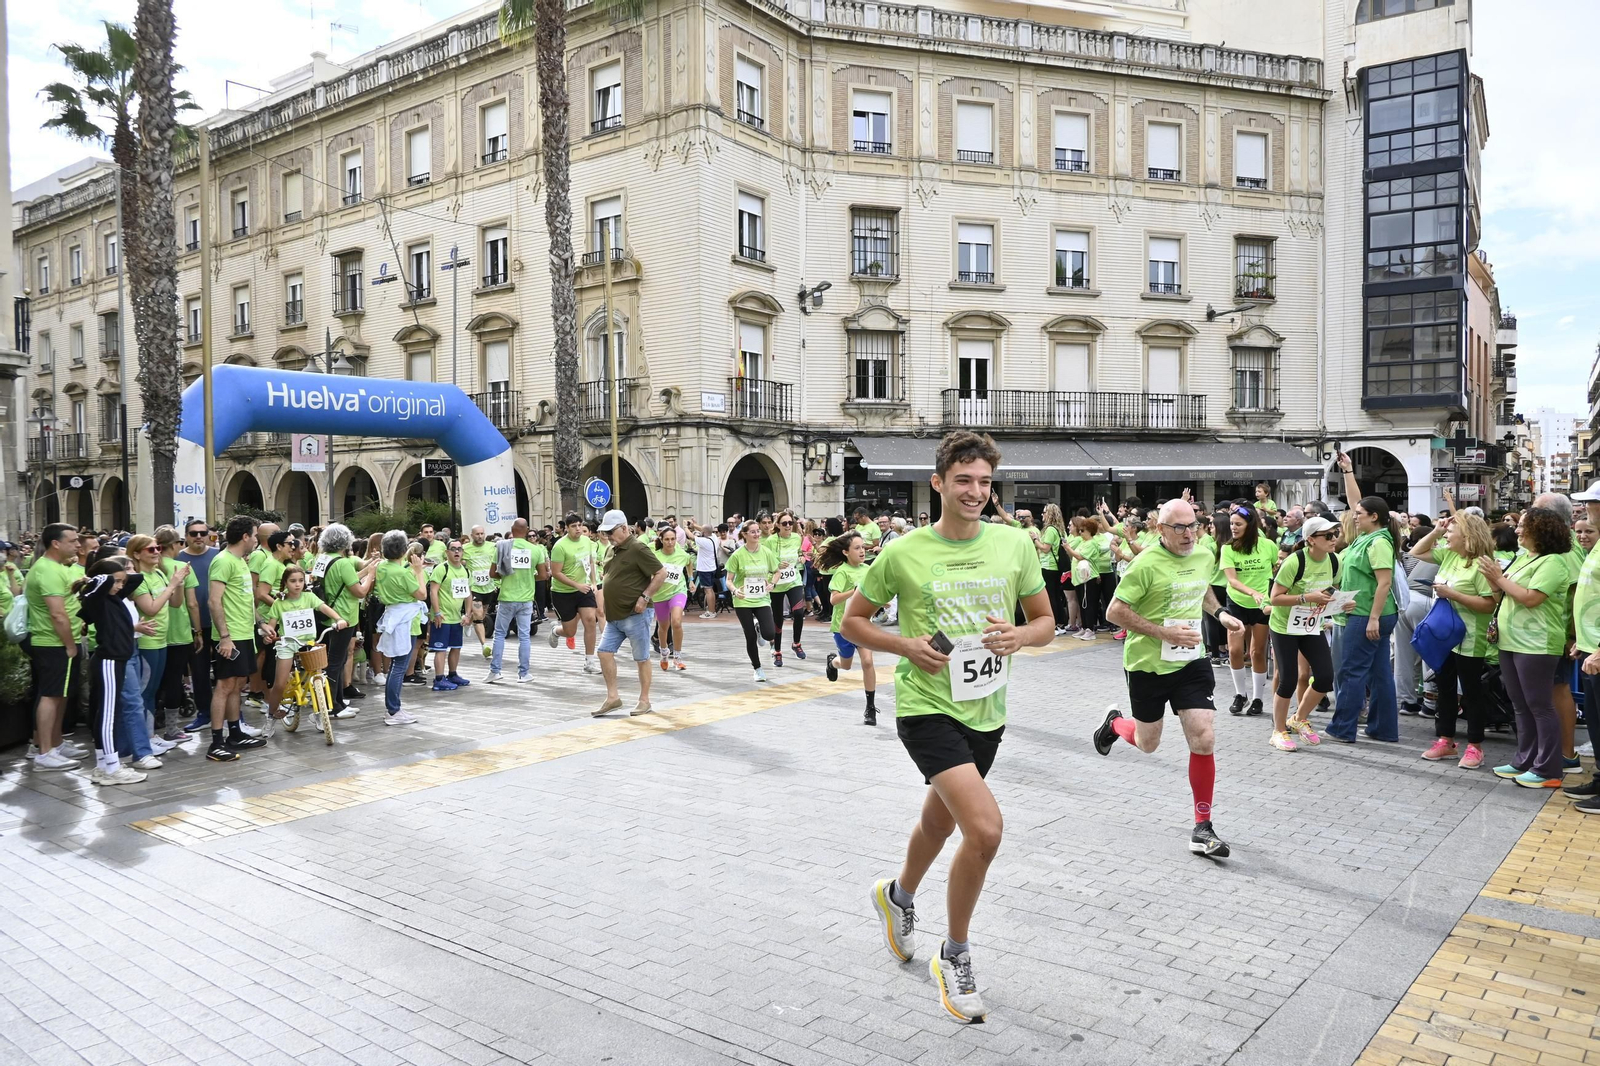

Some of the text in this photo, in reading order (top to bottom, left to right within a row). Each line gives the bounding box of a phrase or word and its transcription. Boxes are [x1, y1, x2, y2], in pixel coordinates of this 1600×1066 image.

[267, 381, 446, 420] Huelva original
[175, 482, 205, 495] uelv
[514, 556, 530, 564] 540
[455, 586, 467, 594] 541
[749, 585, 764, 594] 291
[932, 575, 1007, 592] En marcha
[935, 590, 1005, 608] contra el
[921, 581, 937, 635] HUELVA
[938, 605, 1006, 626] cáncer
[291, 618, 313, 630] 438
[963, 654, 1003, 683] 548
